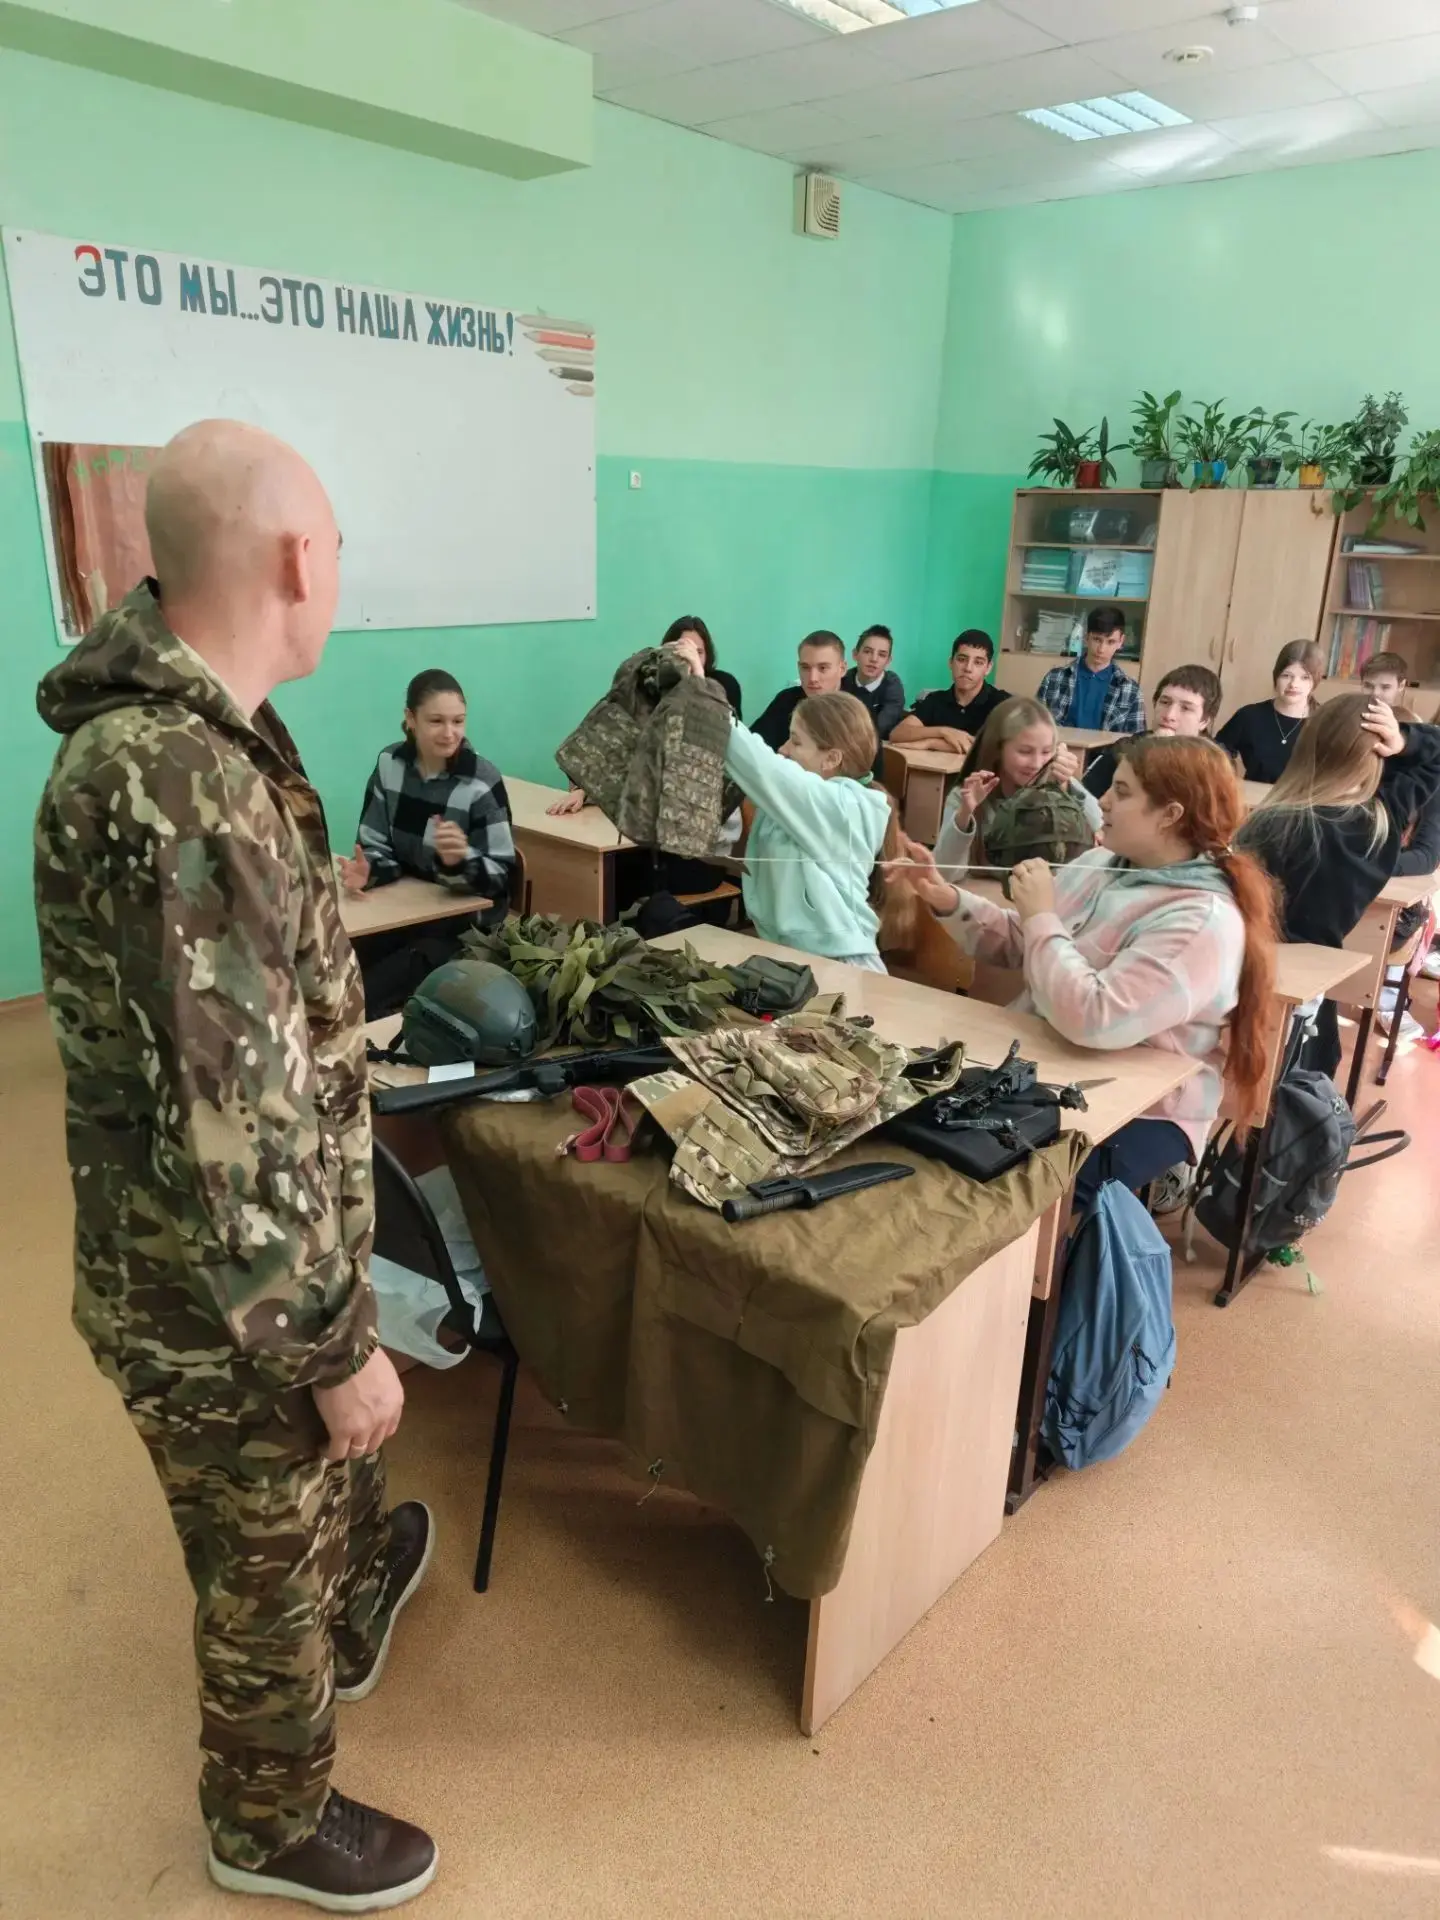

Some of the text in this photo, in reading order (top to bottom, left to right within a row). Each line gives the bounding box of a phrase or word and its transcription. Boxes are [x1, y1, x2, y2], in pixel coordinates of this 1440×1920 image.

[74, 244, 162, 305] ЭТО
[335, 286, 419, 342] НАША
[424, 301, 515, 356] ЖИЗНЬ!
